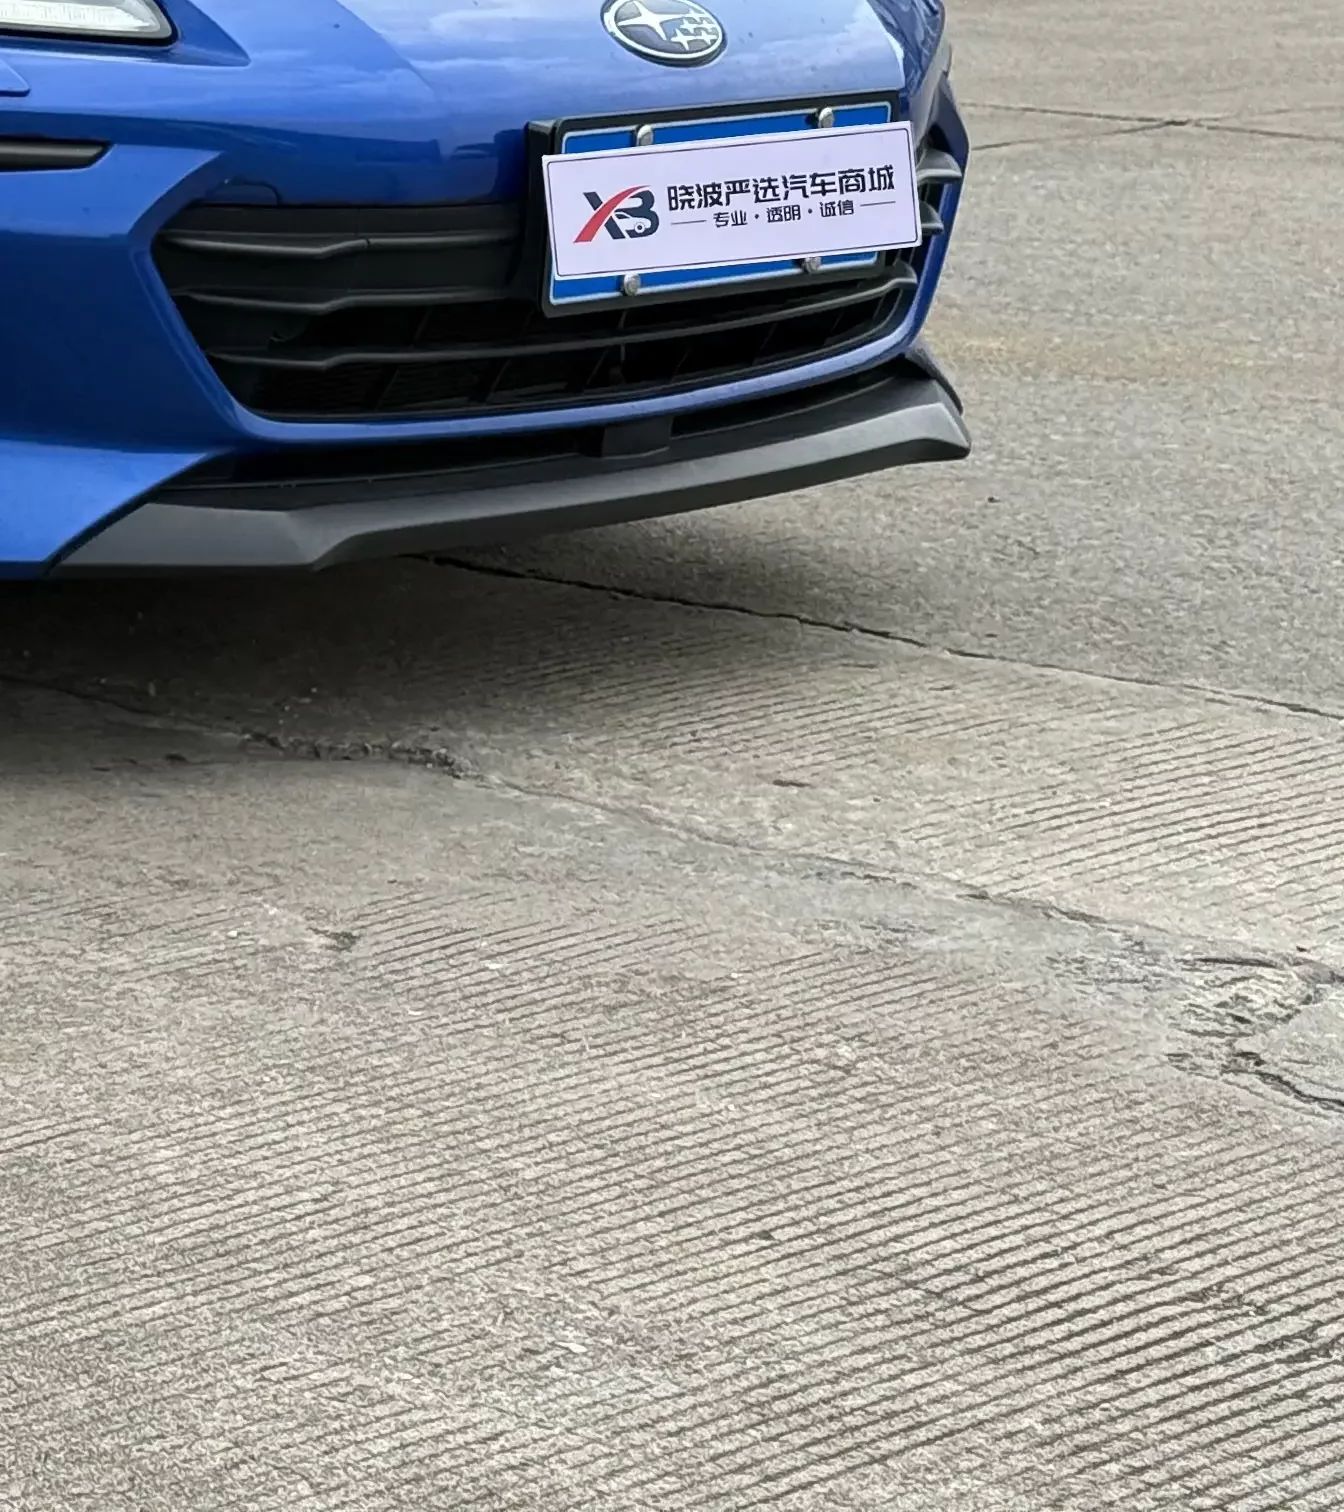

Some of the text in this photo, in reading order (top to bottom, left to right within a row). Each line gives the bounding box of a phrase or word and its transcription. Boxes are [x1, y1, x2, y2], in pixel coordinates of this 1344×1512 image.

[666, 164, 896, 212] 晓波严选汽车商城
